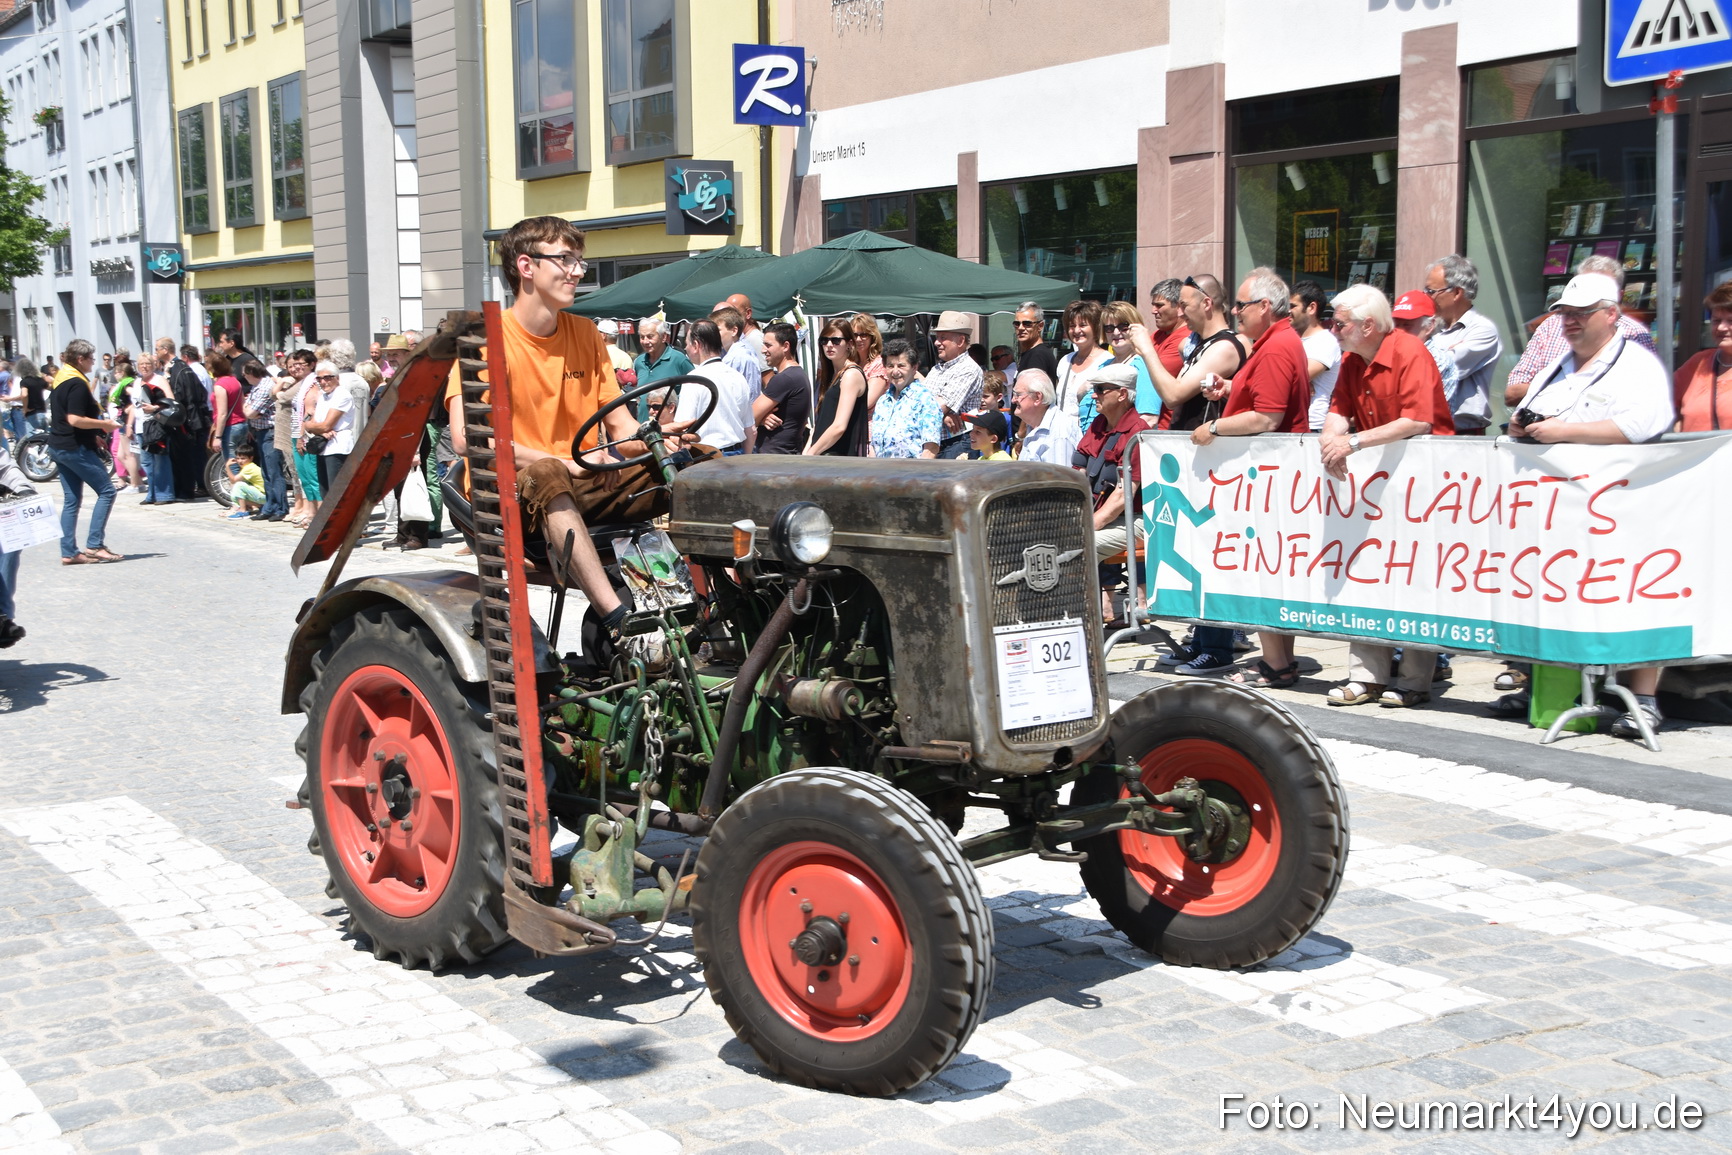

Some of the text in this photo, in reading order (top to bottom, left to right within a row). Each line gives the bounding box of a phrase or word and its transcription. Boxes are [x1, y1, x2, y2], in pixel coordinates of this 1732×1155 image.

[812, 141, 866, 164] Unterer Markt 15
[694, 180, 718, 211] G2
[1304, 226, 1329, 239] WEBER'S
[1304, 238, 1329, 255] GRILL
[157, 254, 172, 271] G2
[1304, 255, 1329, 273] BIBEL
[1290, 470, 1389, 521] UNS
[22, 505, 43, 519] 594
[1030, 553, 1054, 573] HELA
[1435, 542, 1692, 604] BESSER.
[1031, 572, 1056, 583] DIESEL
[1279, 606, 1381, 632] Service-Line:
[1386, 617, 1396, 633] 0
[1041, 640, 1072, 664] 302
